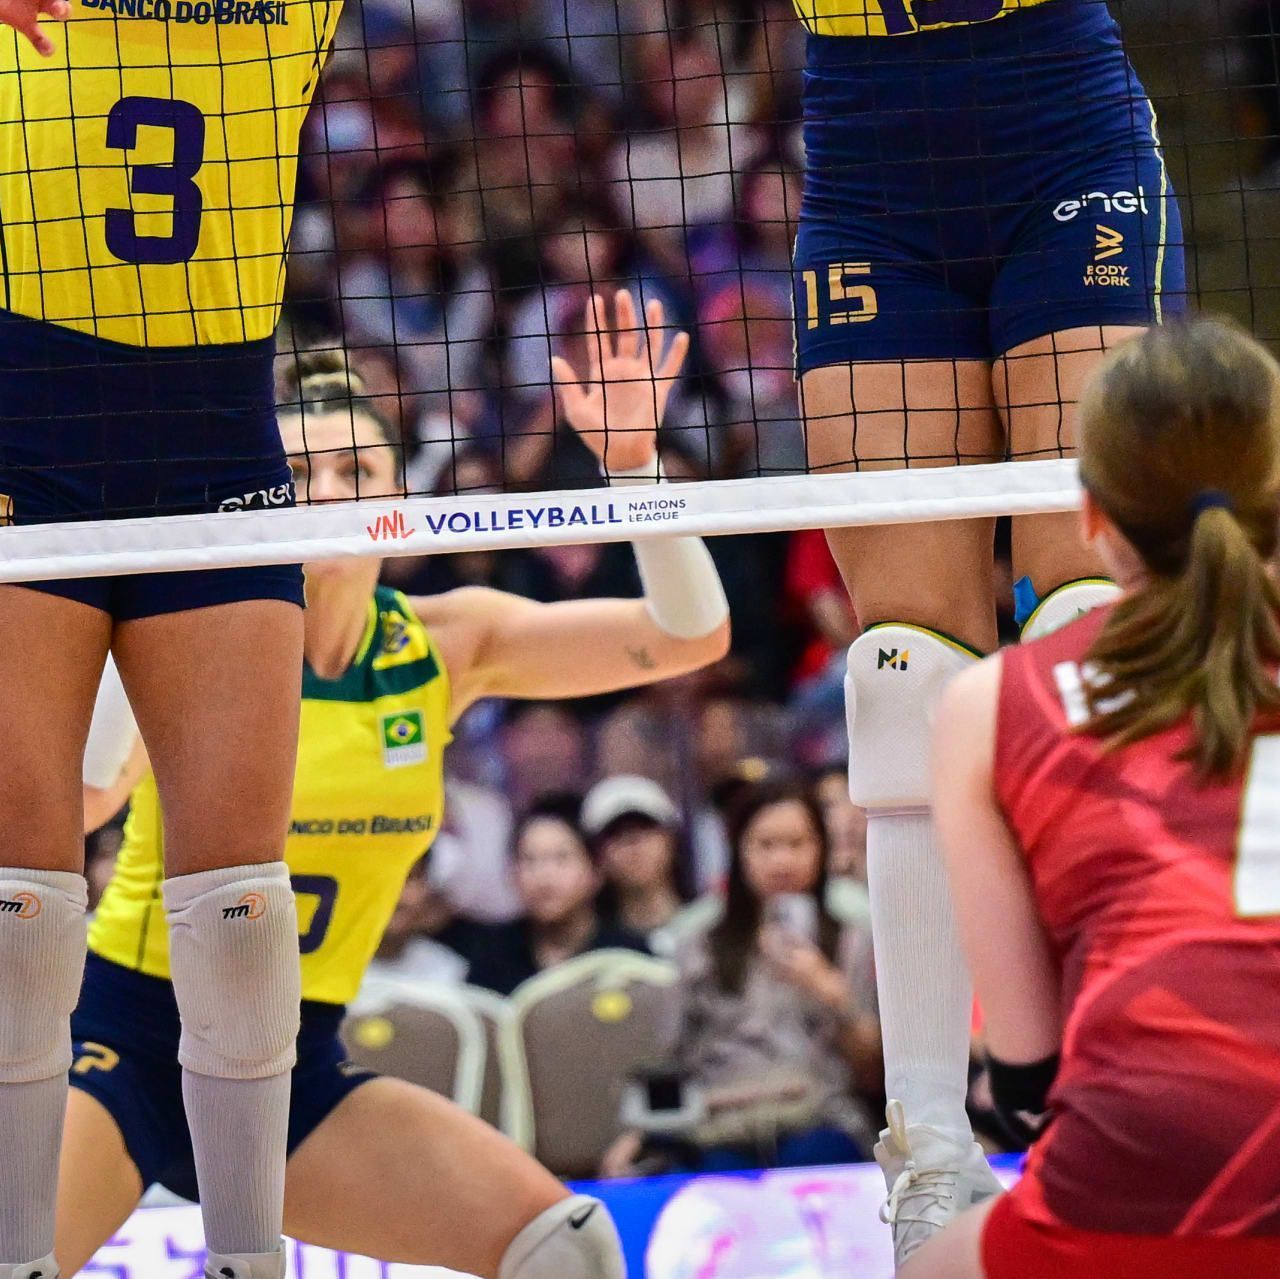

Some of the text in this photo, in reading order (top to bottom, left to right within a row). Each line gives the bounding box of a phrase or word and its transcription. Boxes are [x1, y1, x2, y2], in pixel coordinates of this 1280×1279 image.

[175, 0, 212, 25] DO
[105, 95, 206, 266] 3
[1052, 185, 1149, 222] enel
[1082, 275, 1131, 287] WORK
[1086, 264, 1129, 276] BODY
[802, 261, 879, 331] 15
[628, 498, 687, 511] NATIONS
[628, 511, 680, 523] LEAGUE
[366, 503, 624, 541] VNL VOLLEYBALL
